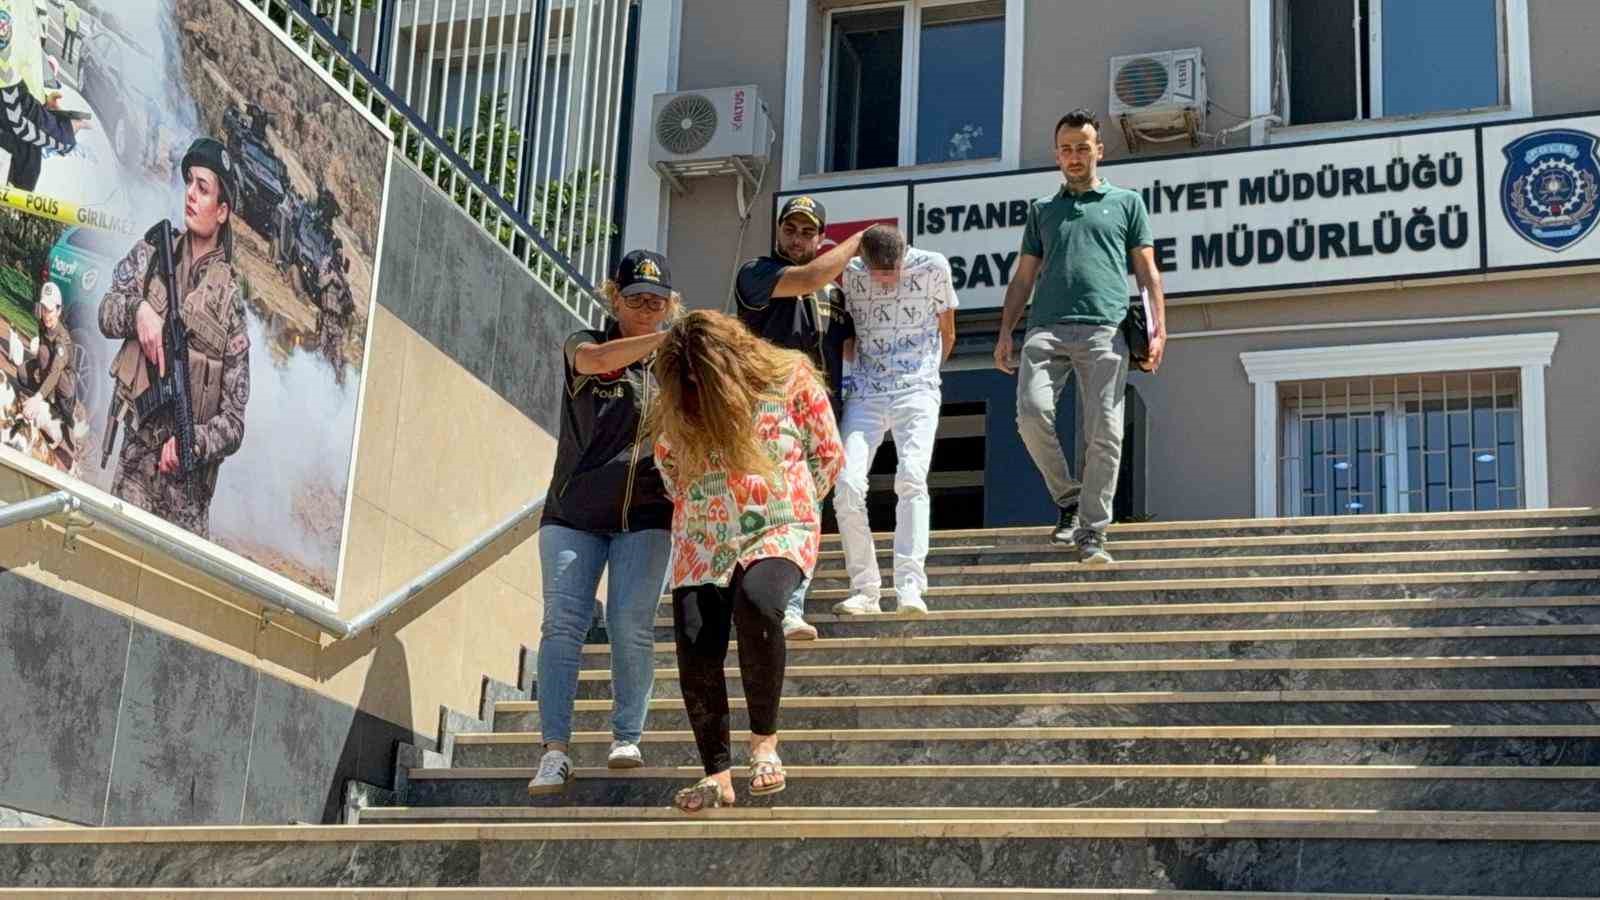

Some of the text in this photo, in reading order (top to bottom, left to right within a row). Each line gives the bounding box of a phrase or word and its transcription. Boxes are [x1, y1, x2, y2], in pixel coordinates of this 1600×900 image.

[917, 152, 1463, 236] İSTANB İYET MÜDÜRLÜĞÜ
[949, 251, 1018, 291] SAY
[1191, 205, 1468, 270] MÜDÜRLÜĞÜ
